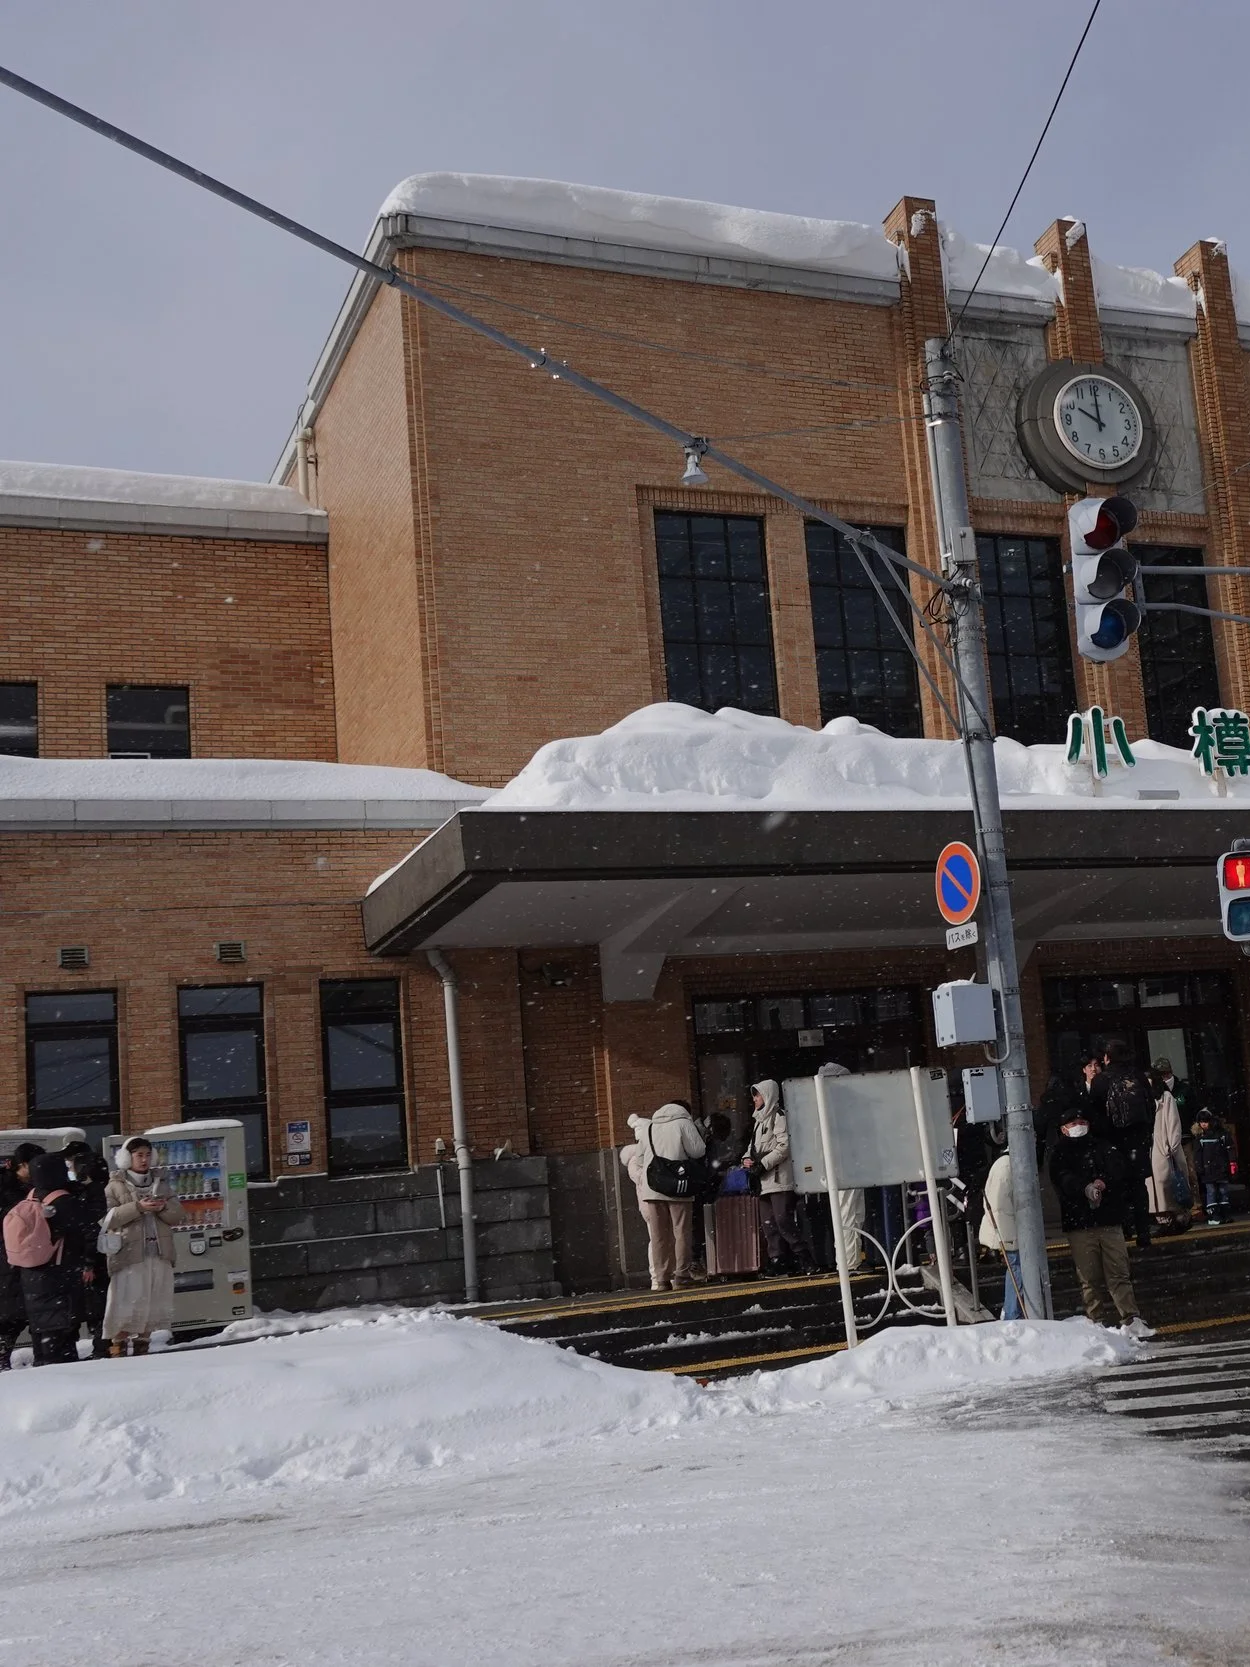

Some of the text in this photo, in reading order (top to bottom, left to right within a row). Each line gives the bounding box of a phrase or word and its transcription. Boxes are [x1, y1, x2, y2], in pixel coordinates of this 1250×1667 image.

[1076, 388, 1084, 399] 11
[1118, 402, 1126, 414] 2
[1065, 413, 1072, 426] 9
[1124, 419, 1132, 430] 3
[1071, 431, 1079, 442] 8
[1121, 435, 1130, 447] 4
[1084, 443, 1092, 454] 7
[1098, 448, 1106, 460] 6
[1112, 445, 1120, 457] 5
[948, 928, 976, 945] バスを除く
